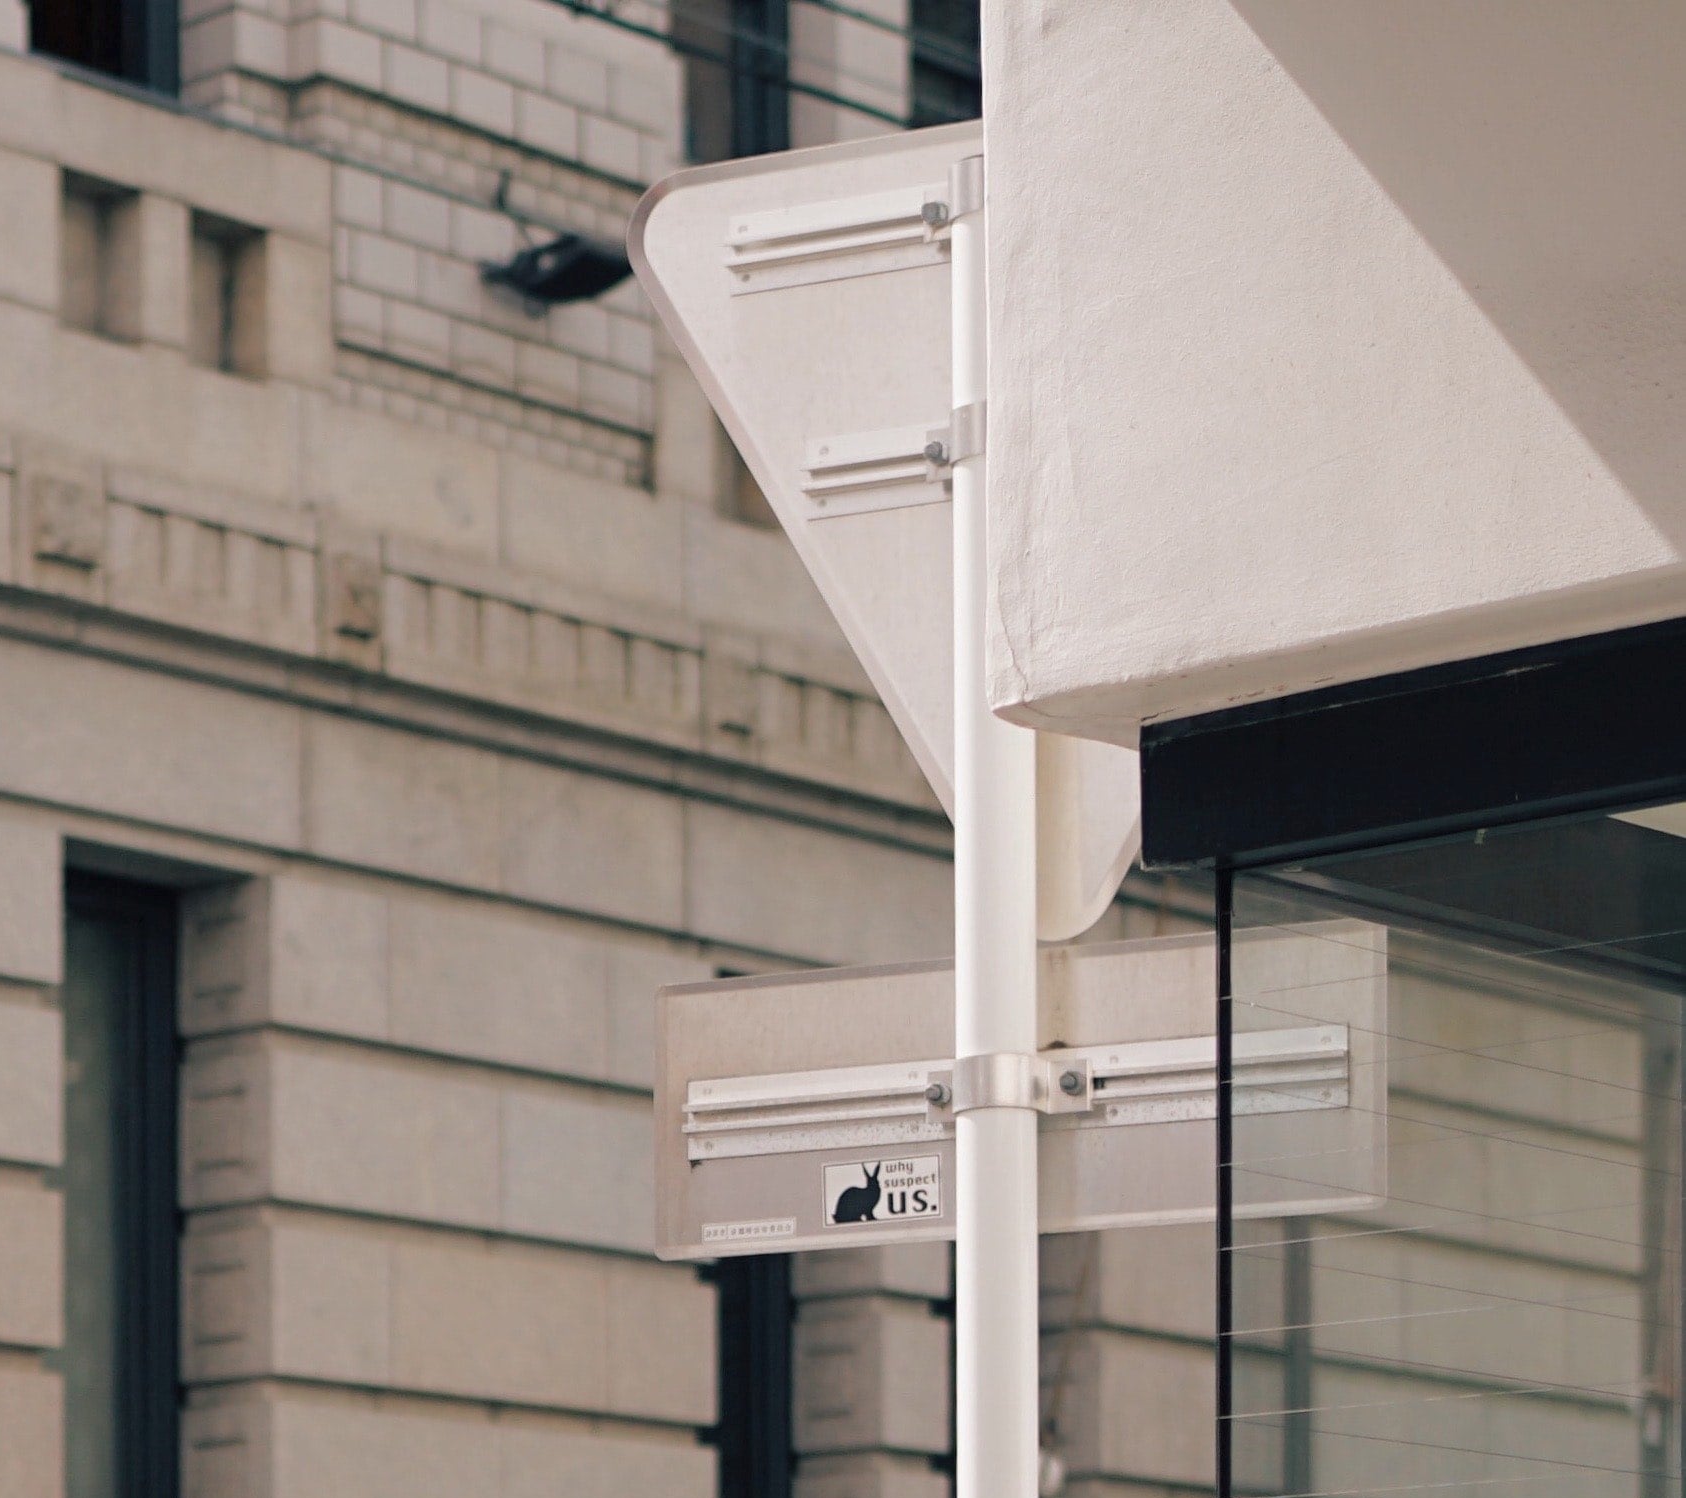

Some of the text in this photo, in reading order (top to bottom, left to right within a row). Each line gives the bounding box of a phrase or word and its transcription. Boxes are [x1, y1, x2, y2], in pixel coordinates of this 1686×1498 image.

[885, 1160, 914, 1175] why
[883, 1173, 936, 1189] suspect
[887, 1188, 937, 1215] us.
